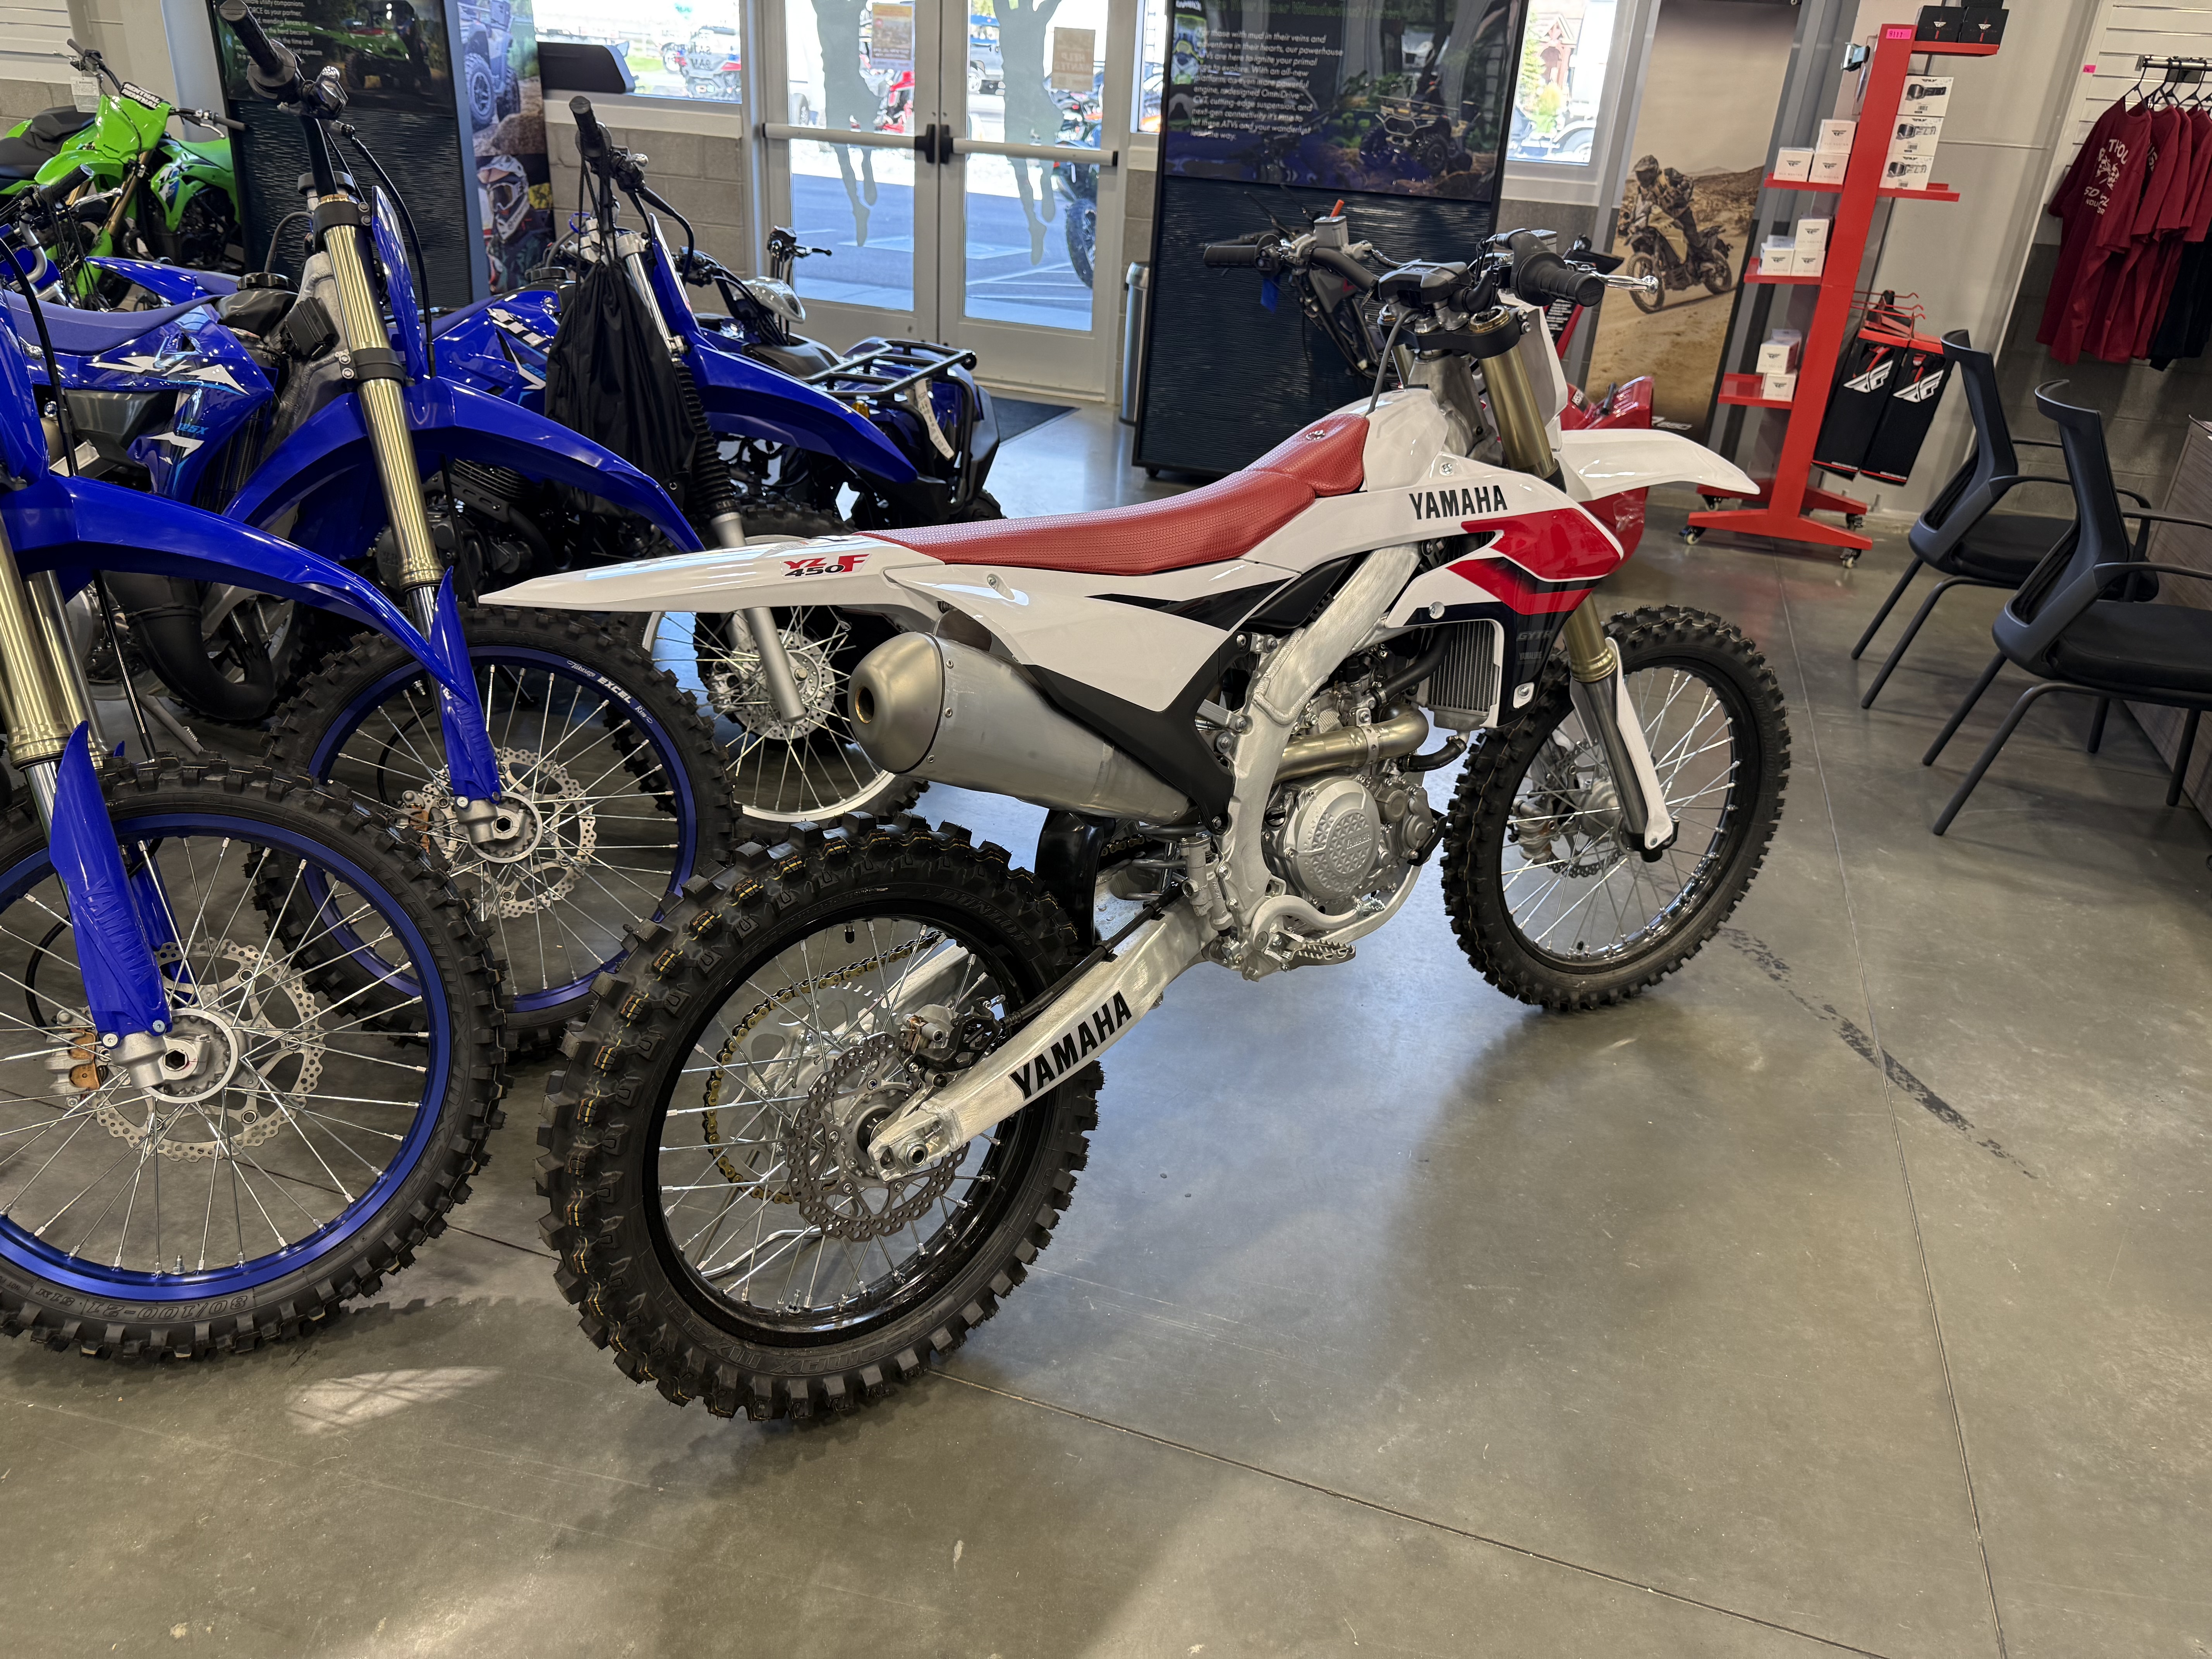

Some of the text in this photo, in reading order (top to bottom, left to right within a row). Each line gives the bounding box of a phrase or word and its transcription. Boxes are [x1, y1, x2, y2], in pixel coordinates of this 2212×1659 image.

[1231, 29, 1247, 38] with
[1247, 31, 1264, 40] mud
[1265, 31, 1272, 40] in
[1273, 32, 1291, 41] their
[1291, 34, 1310, 43] veins
[1310, 34, 1327, 43] and
[1298, 45, 1343, 57] powerhouse
[1293, 57, 1318, 67] primal
[1297, 103, 1313, 112] and
[1409, 485, 1507, 520] YAMAHA
[784, 557, 827, 569] YZ
[597, 676, 633, 704] EXCEL
[635, 705, 653, 724] Rim
[82, 878, 151, 986] YAMAHA
[937, 888, 1031, 946] DUNLOP
[376, 869, 468, 1050] GEOMAX
[1010, 991, 1132, 1099] YAMAHA
[85, 1295, 248, 1321] 80/100-21
[770, 1312, 933, 1374] GEOMAX
